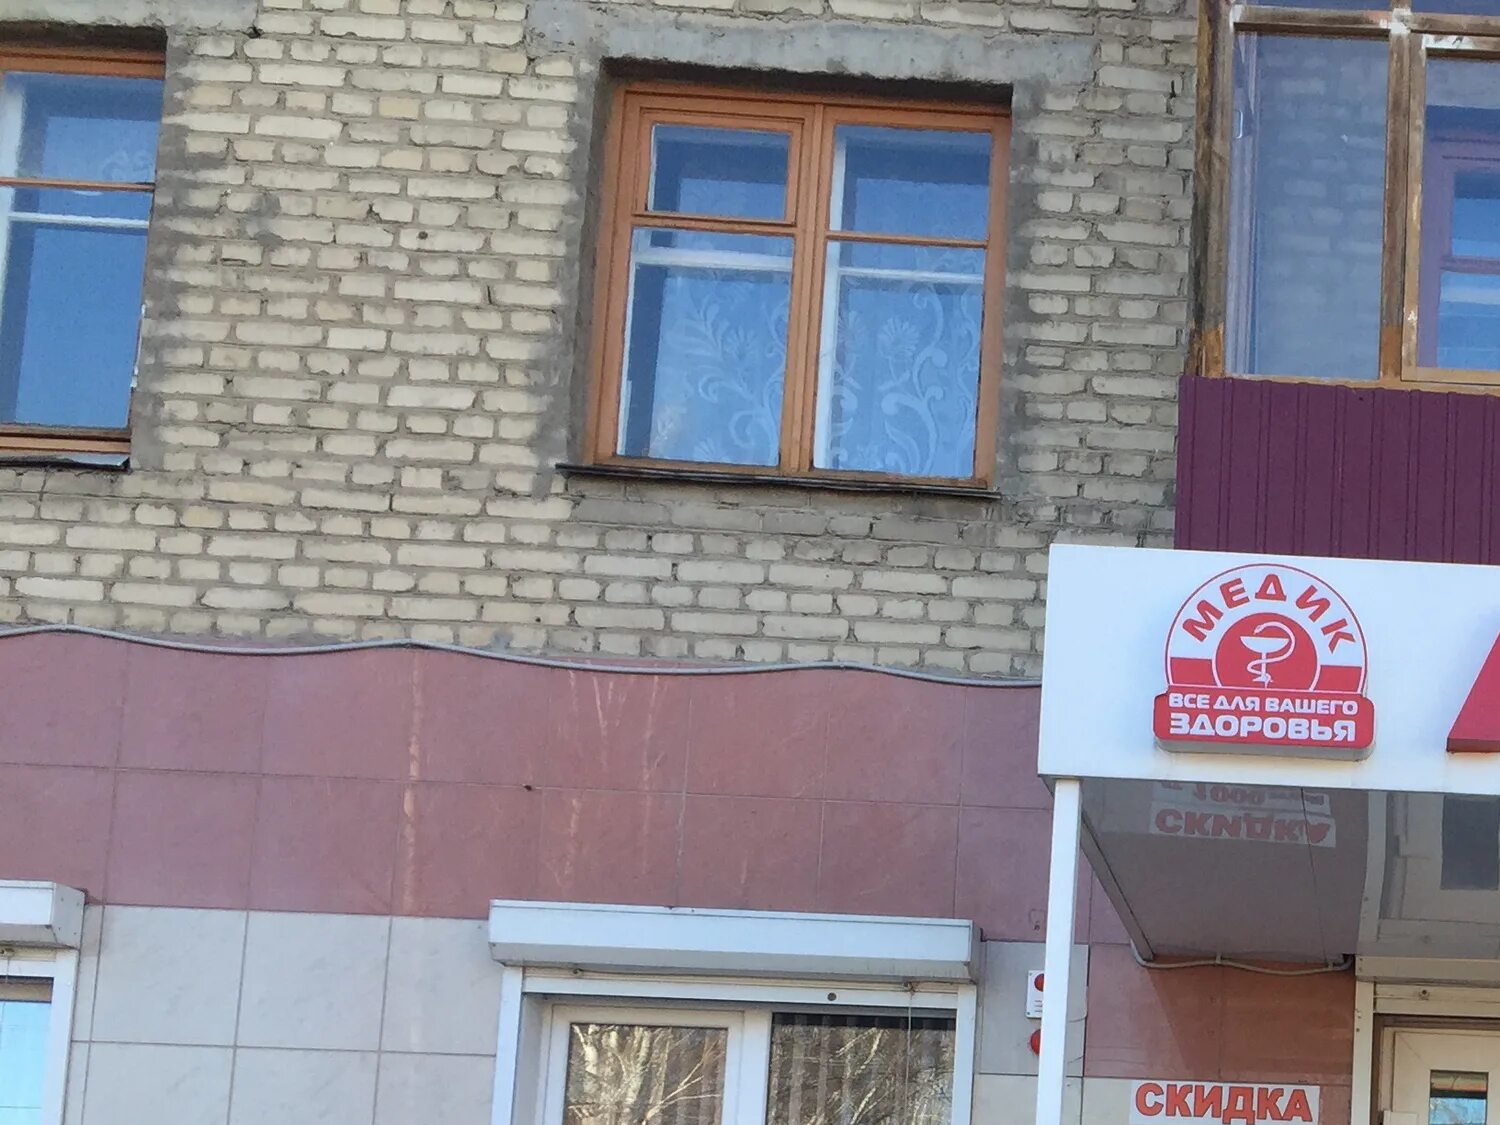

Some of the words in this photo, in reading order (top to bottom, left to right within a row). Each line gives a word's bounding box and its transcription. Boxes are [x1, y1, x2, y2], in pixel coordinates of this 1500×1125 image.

[1183, 573, 1356, 654] МЕДИК
[1168, 693, 1210, 710] ВСЕ
[1213, 695, 1260, 713] ДЛЯ
[1265, 697, 1359, 716] ВАШЕГО
[1170, 713, 1356, 742] ЗДОРОВЬЯ
[1135, 1083, 1313, 1125] СКИДКА
